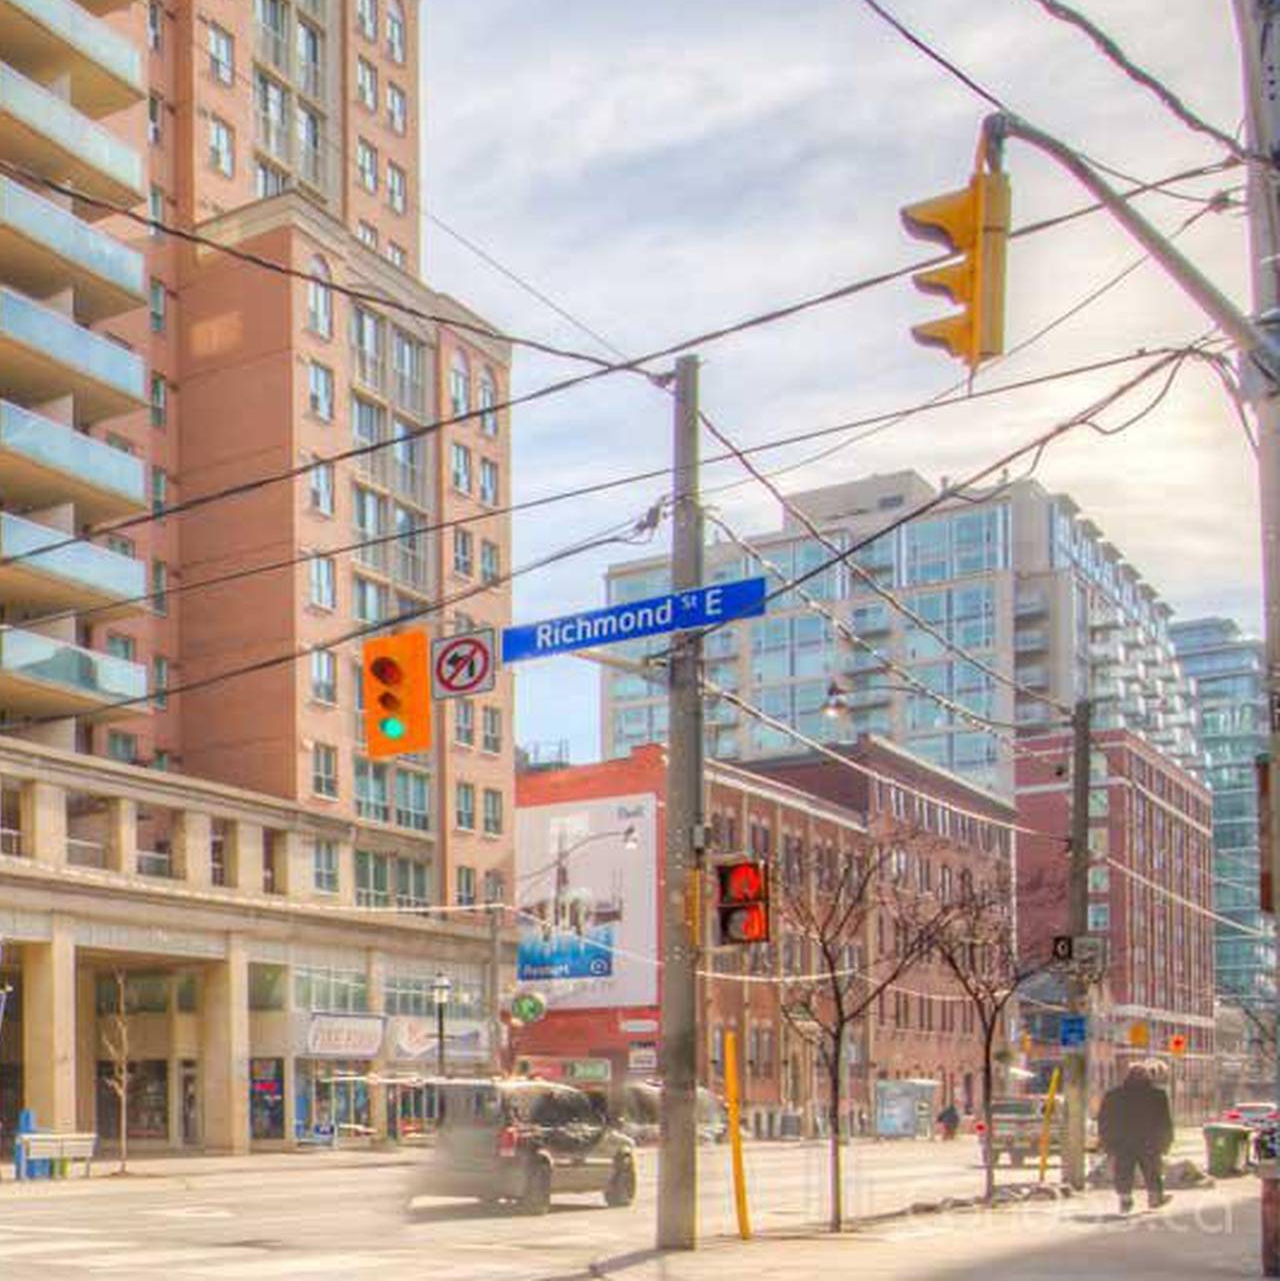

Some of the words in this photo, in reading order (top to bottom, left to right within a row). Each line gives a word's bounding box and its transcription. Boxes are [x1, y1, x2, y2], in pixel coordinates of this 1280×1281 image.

[536, 599, 673, 649] Richmond
[681, 594, 698, 610] St
[705, 589, 723, 616] E
